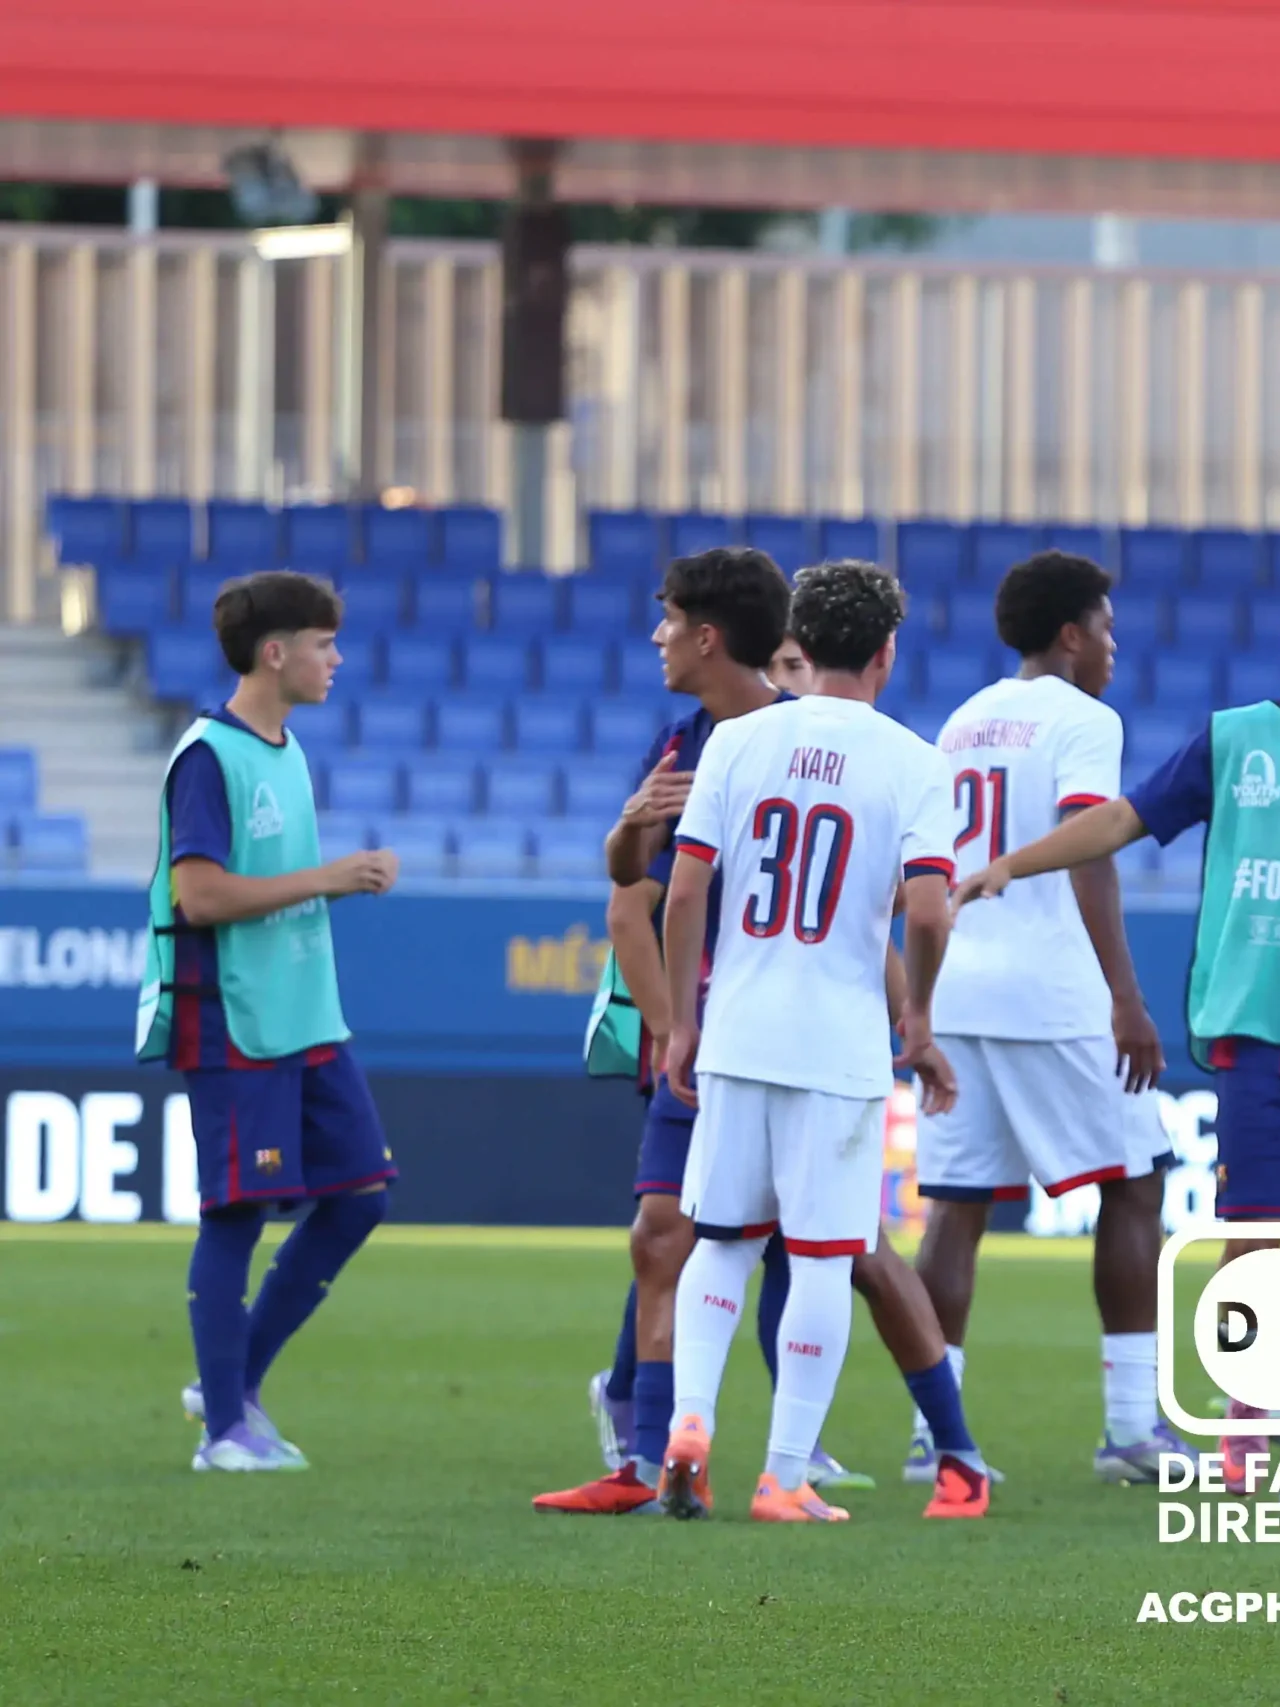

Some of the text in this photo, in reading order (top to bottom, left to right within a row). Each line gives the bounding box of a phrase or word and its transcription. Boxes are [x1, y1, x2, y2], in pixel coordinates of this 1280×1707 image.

[788, 747, 847, 786] AYARI
[953, 767, 1008, 896] 21
[742, 797, 854, 945] 30
[3, 1091, 143, 1224] DE
